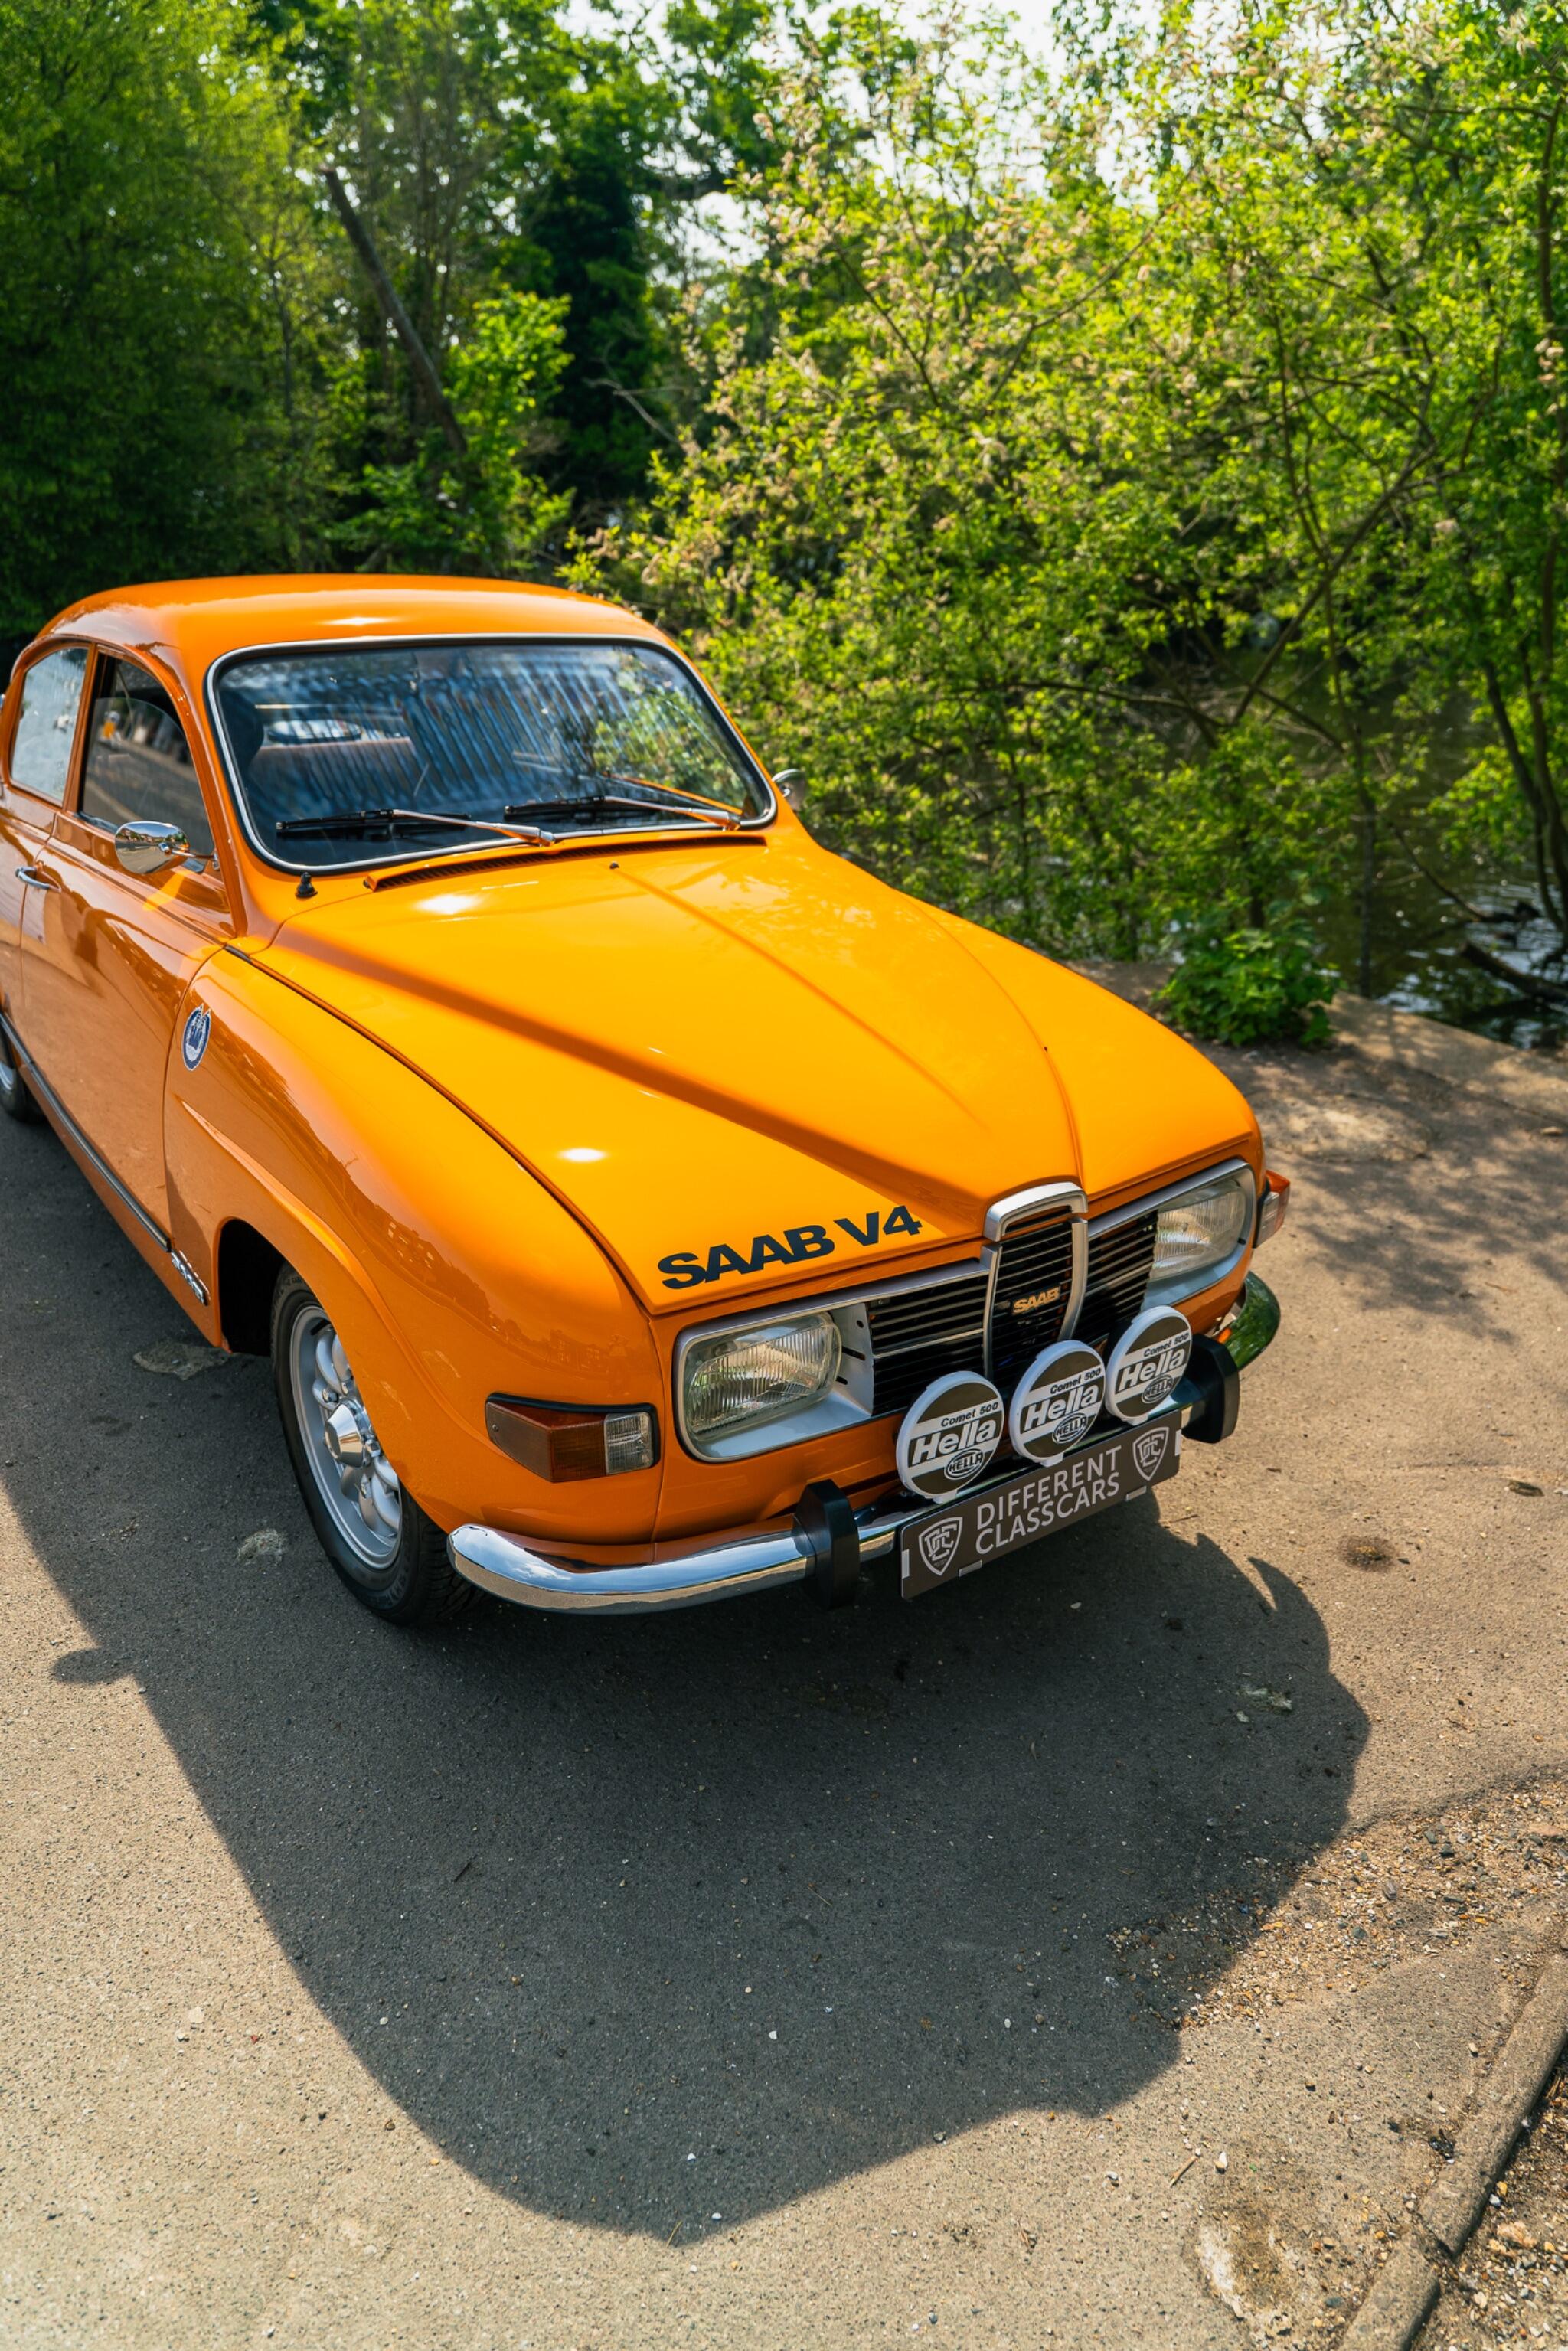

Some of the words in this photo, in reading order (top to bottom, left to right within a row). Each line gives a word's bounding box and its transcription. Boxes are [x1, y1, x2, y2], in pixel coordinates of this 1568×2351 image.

[657, 1224, 836, 1289] SAAB
[833, 1204, 923, 1247] V4
[1013, 1286, 1060, 1314] SAAB
[1143, 1340, 1171, 1358] Comet
[1173, 1332, 1190, 1345] 500
[1050, 1374, 1082, 1395] Comet
[1083, 1367, 1102, 1381] 500
[1118, 1348, 1186, 1392] Hella
[941, 1408, 976, 1427] Comet
[979, 1402, 999, 1415] 500
[1024, 1384, 1099, 1431] Hella
[912, 1419, 996, 1465] Hella
[1056, 1415, 1087, 1437] HELLA
[948, 1451, 984, 1473] HELLA
[976, 1445, 1122, 1530] DIFFERENT
[975, 1471, 1120, 1555] CLASSCARS
